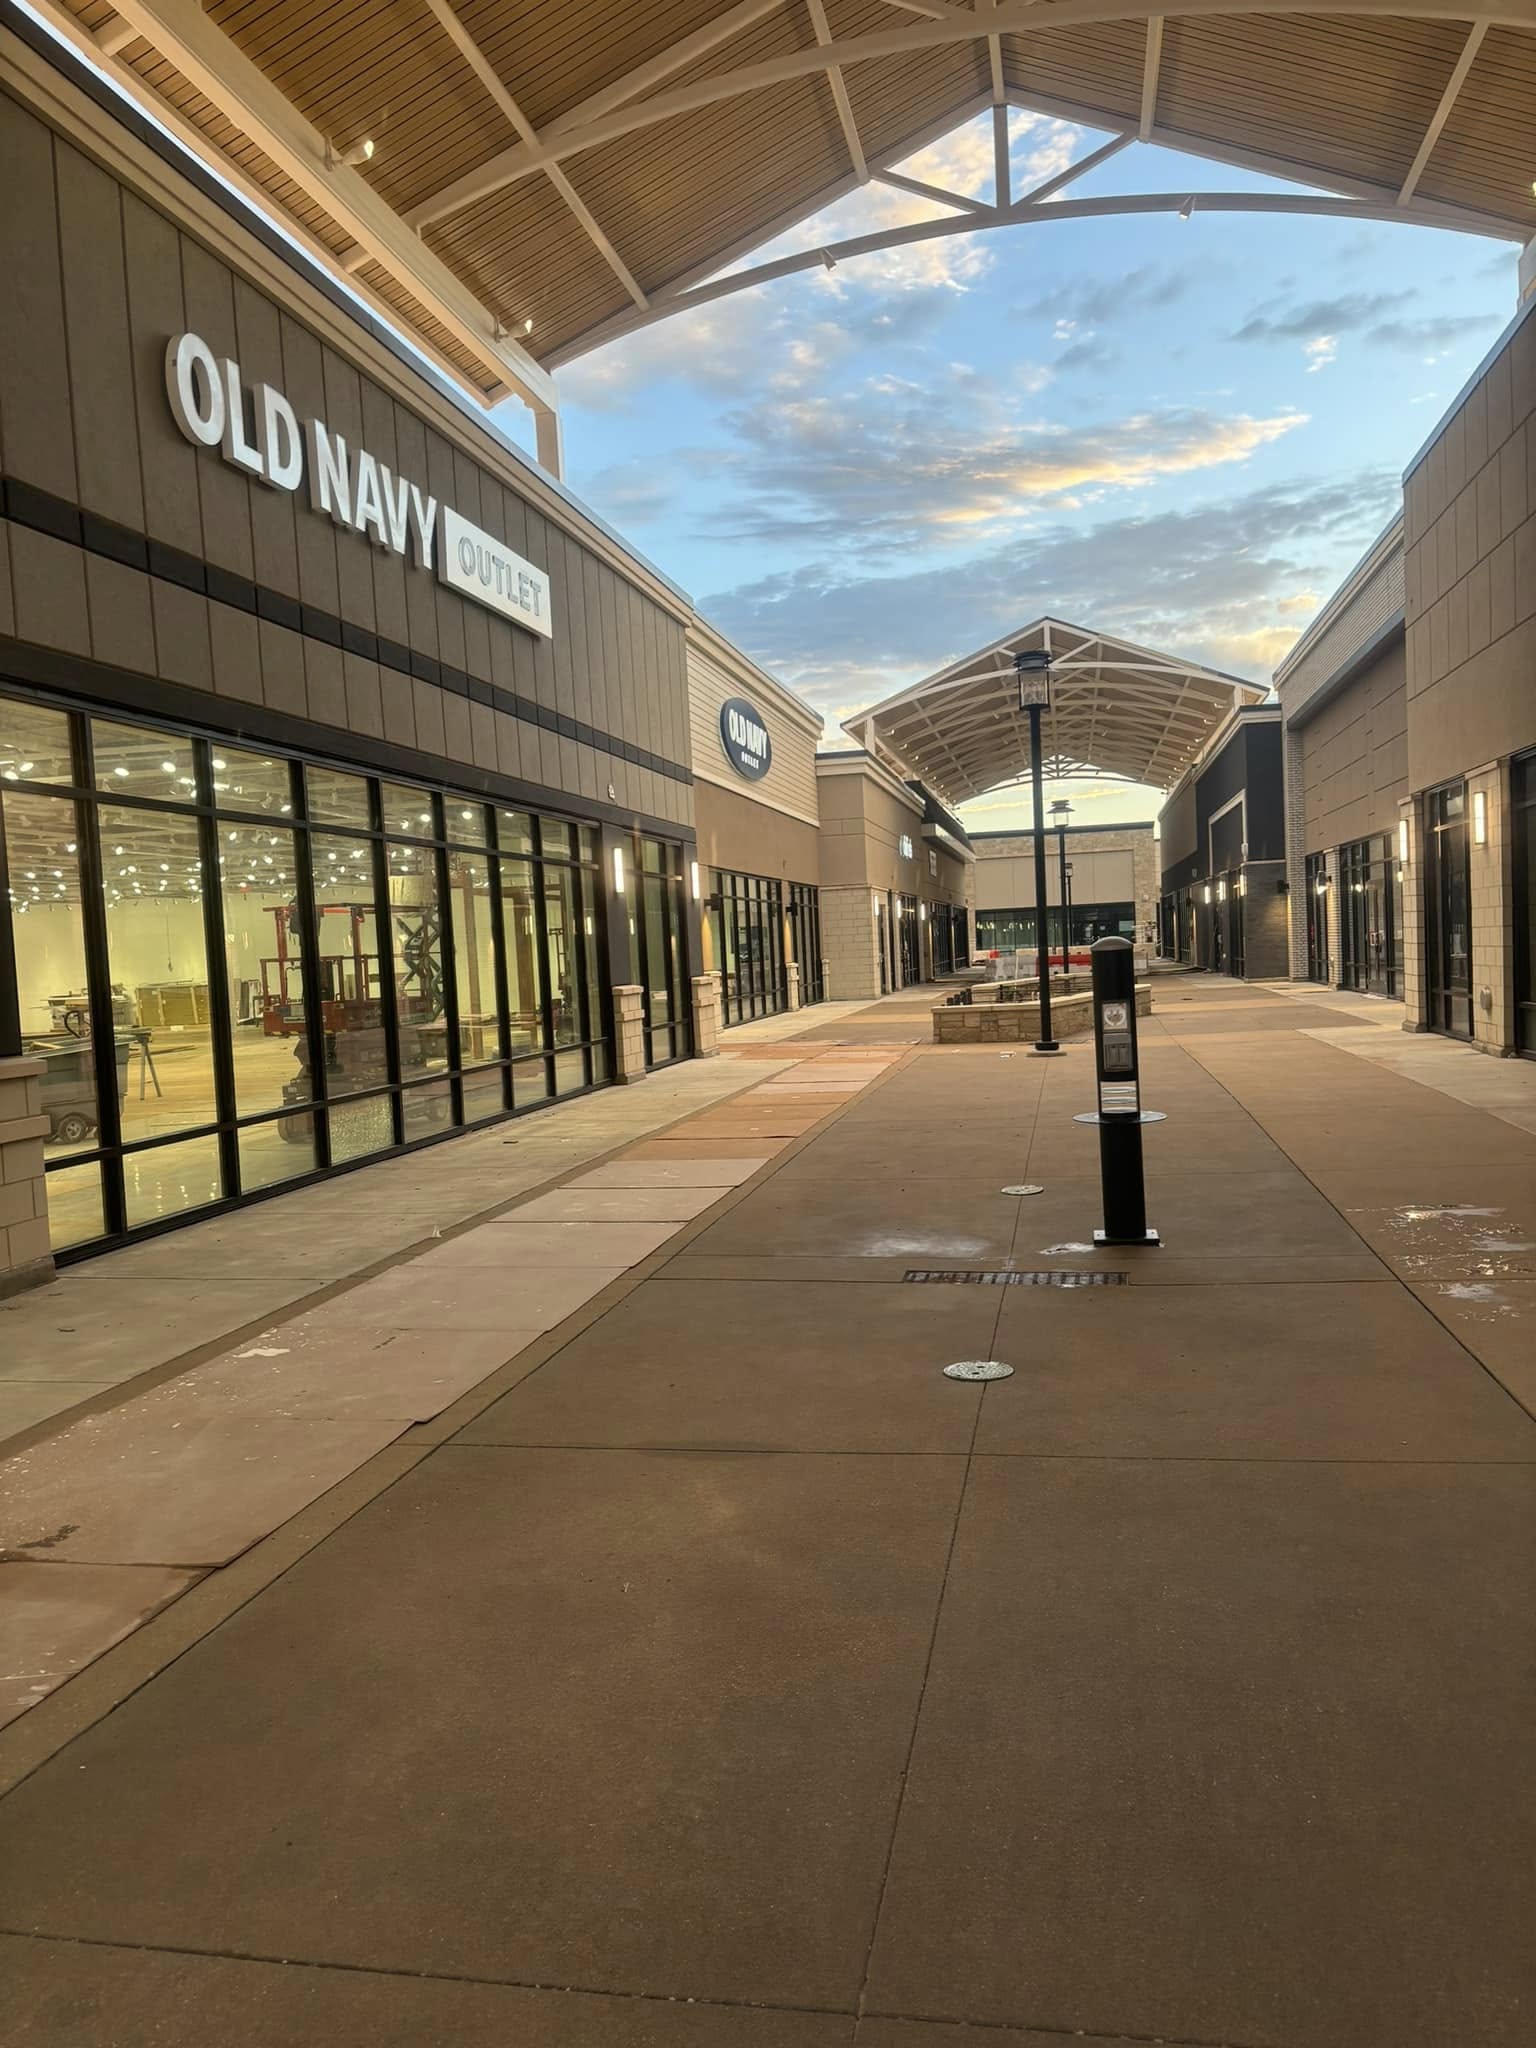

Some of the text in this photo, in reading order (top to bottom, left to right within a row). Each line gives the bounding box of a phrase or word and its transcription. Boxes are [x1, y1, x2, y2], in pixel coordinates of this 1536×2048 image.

[165, 332, 541, 616] OLD NAVY OUTLET
[728, 708, 747, 748] OLD
